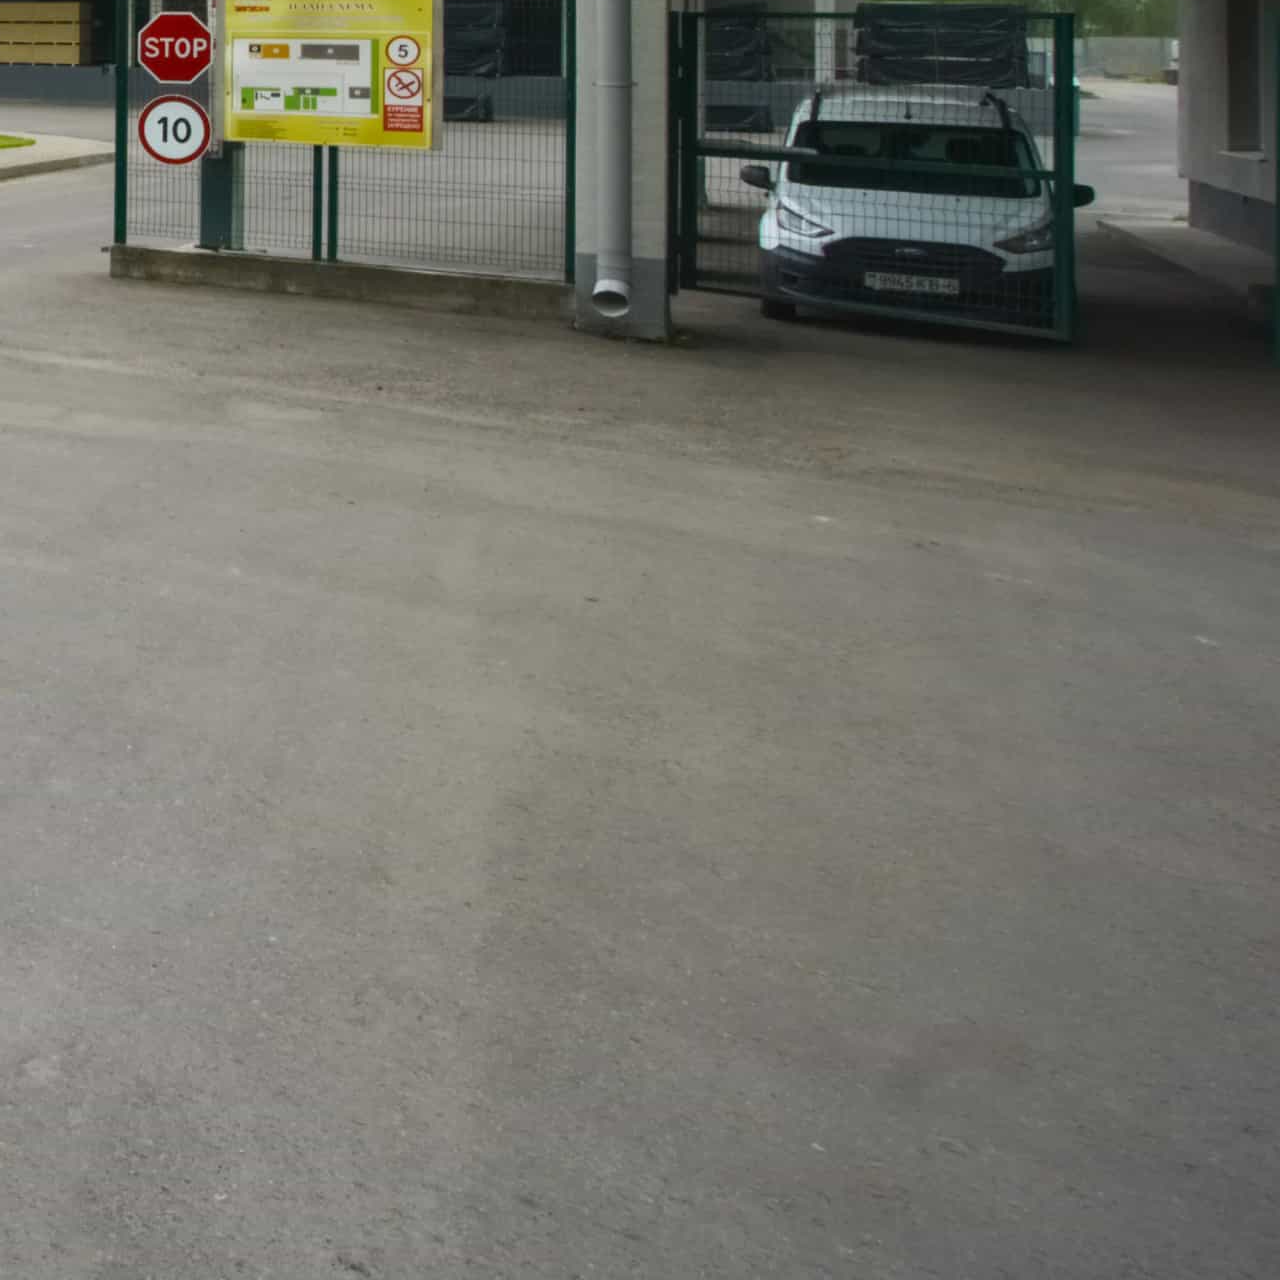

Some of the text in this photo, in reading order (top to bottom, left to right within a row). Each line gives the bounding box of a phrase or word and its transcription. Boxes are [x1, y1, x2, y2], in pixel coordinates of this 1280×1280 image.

[144, 37, 208, 59] STOP
[397, 44, 409, 58] 5
[157, 116, 192, 144] 10
